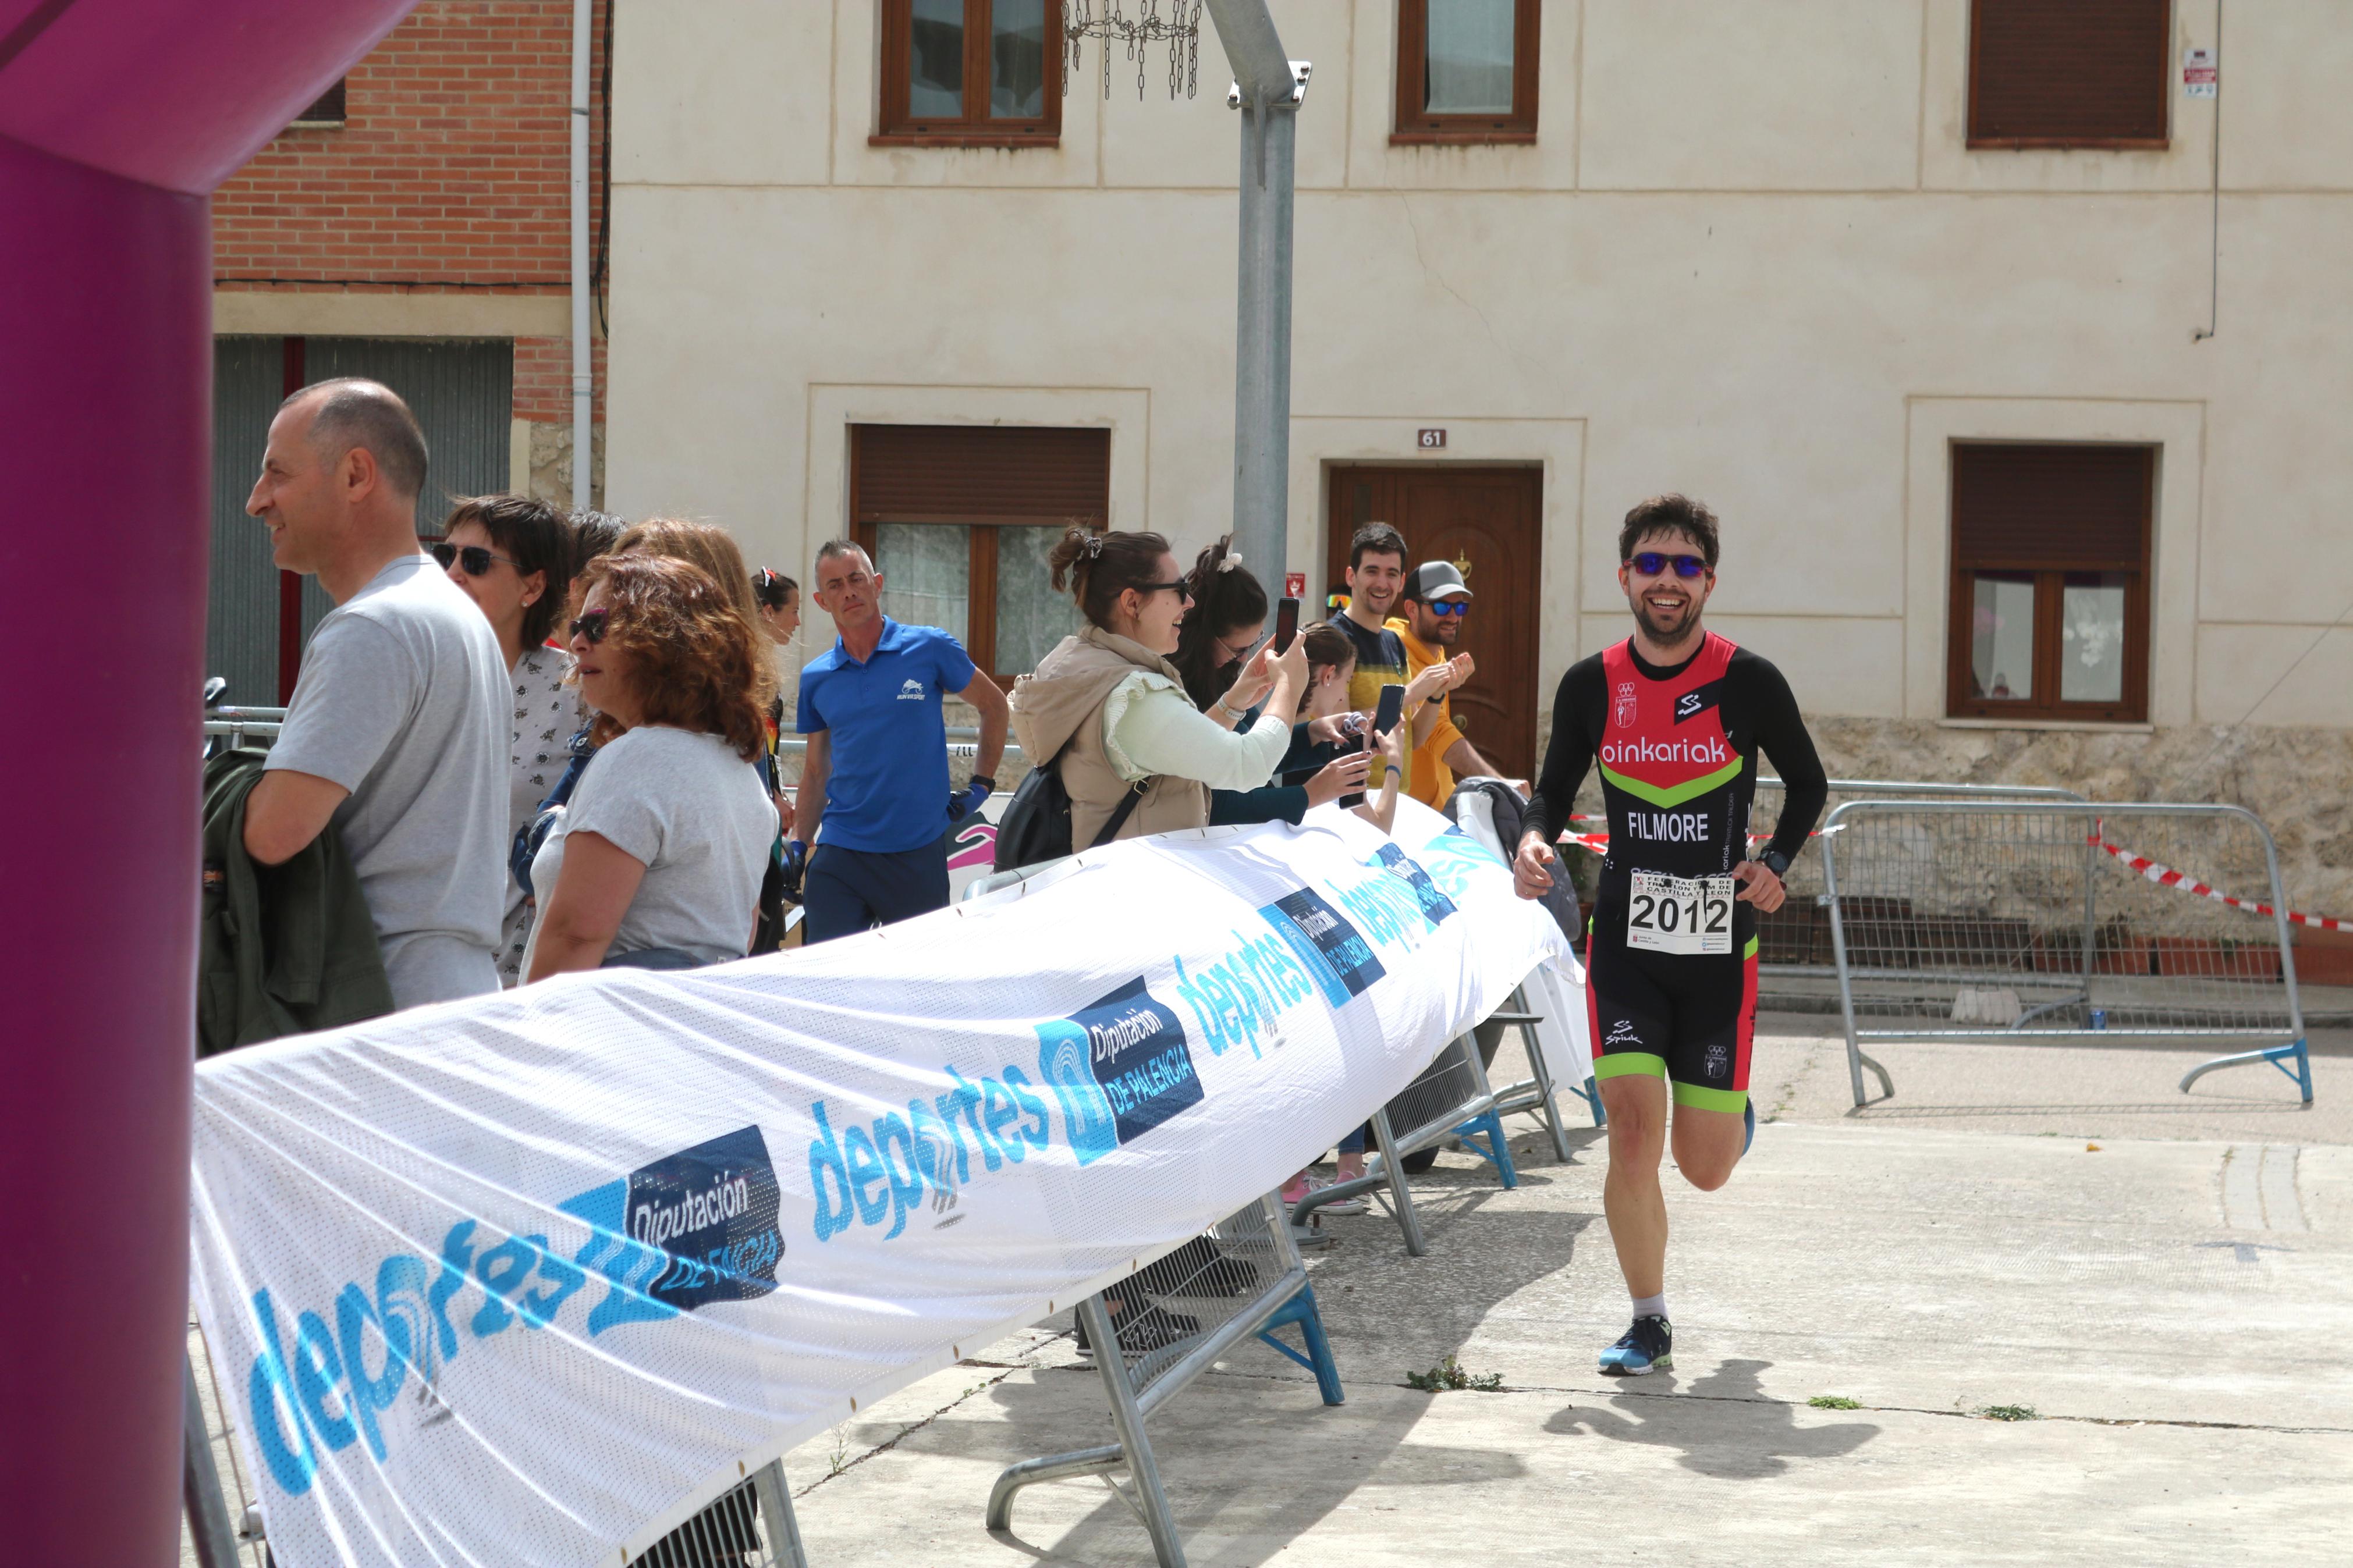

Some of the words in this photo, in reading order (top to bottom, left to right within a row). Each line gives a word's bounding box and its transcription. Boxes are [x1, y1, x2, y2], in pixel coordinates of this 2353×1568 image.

[1422, 431, 1440, 446] 61
[1602, 737, 1726, 763] oinkariak
[1628, 812, 1709, 842] FILMORE
[1646, 881, 1691, 891] TRTLON
[1647, 887, 1693, 897] CASTILLA
[1630, 895, 1728, 934] 2012
[1326, 949, 1349, 977] DE
[1334, 934, 1374, 971] PALENCIA
[1173, 929, 1313, 1060] deportes
[1090, 1008, 1163, 1064] Diputación
[1605, 1034, 1643, 1045] Spiuk
[1105, 1077, 1134, 1115] DE
[1124, 1044, 1193, 1105] PALENCIA
[809, 1064, 1049, 1243] deportes
[634, 1170, 748, 1249] Diputación
